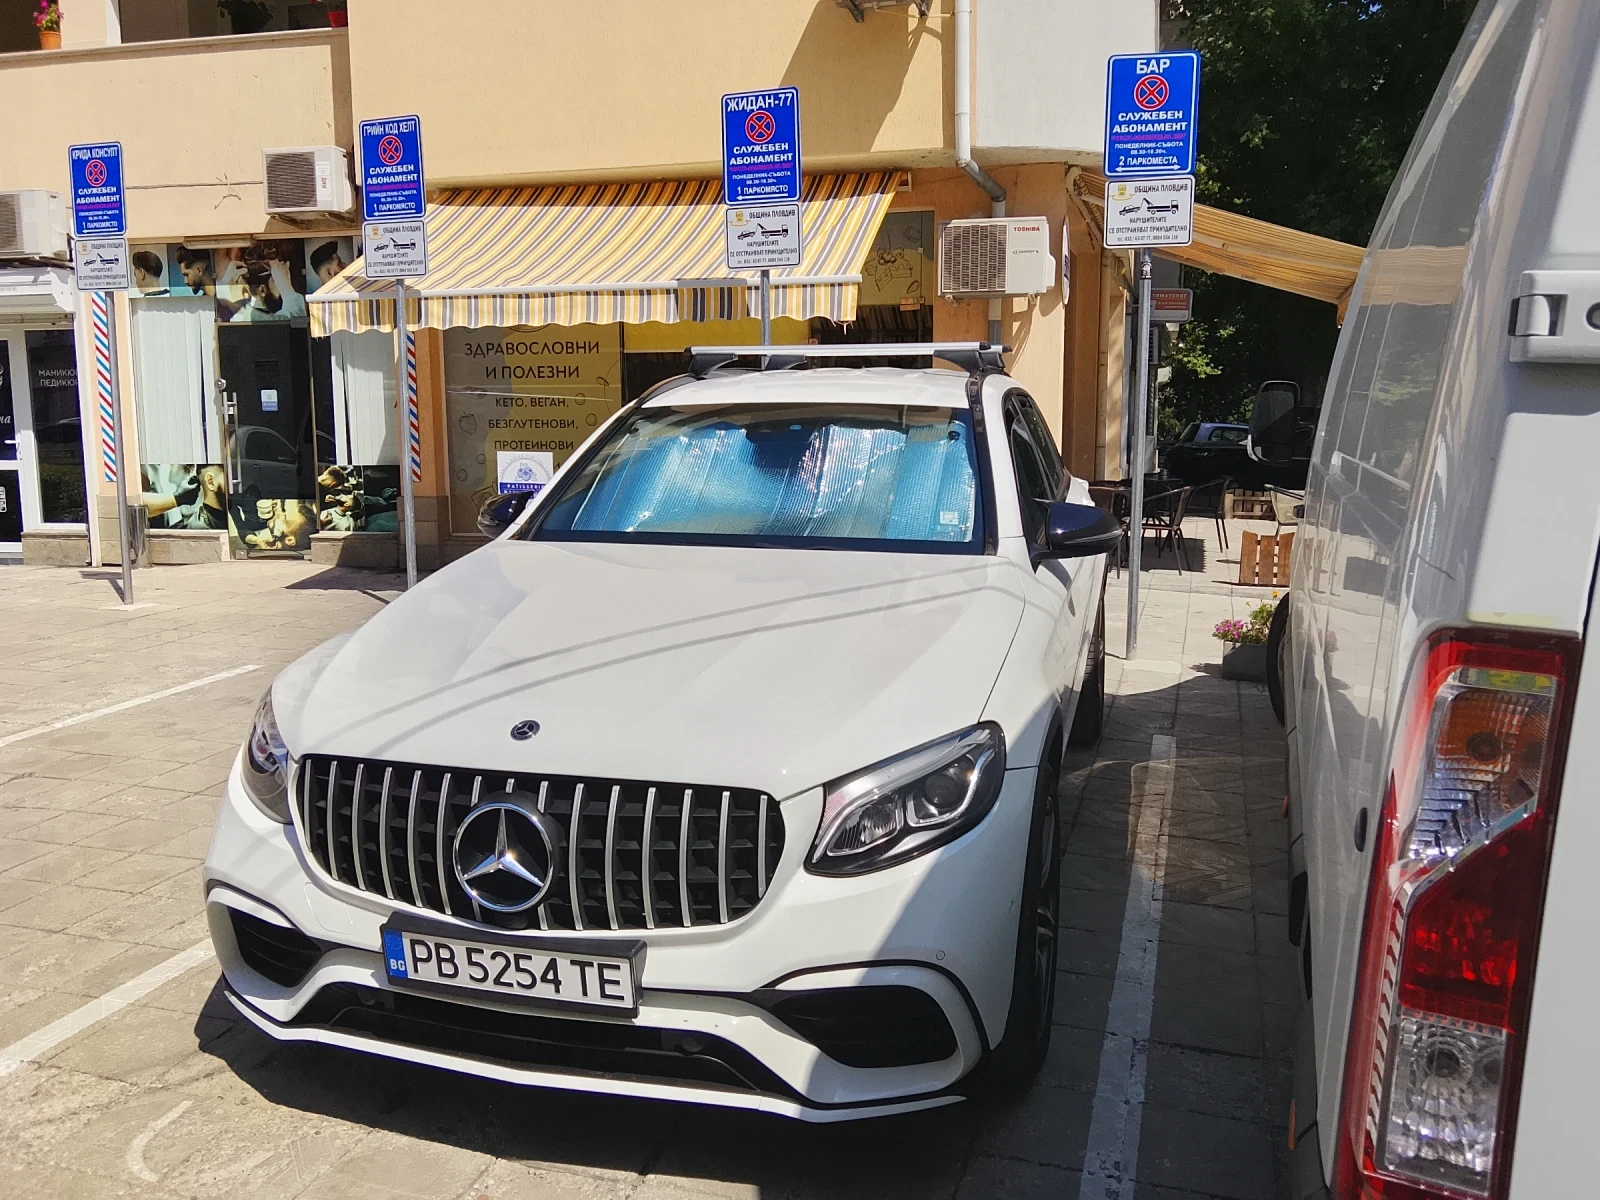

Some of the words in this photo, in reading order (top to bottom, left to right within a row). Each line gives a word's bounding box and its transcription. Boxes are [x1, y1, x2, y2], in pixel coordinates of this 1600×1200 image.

[1136, 58, 1171, 74] БАР
[727, 93, 793, 113] ЖИДАН-77
[1118, 110, 1183, 122] СЛУЖЕБЕН
[363, 123, 384, 137] ГРИЙН
[385, 122, 398, 135] КОД
[399, 120, 415, 133] ХЕЛТ
[1112, 122, 1188, 133] АБОНАМЕНТ
[733, 142, 789, 154] СЛУЖЕБЕН
[1114, 141, 1184, 149] ПОНЕДЕЛНИК-СЪБОТА
[729, 153, 793, 166] АБОНАМЕНТ
[1119, 156, 1125, 165] 2
[1127, 156, 1178, 165] ПАРКОМЕСТА
[369, 163, 414, 175] СЛУЖЕБЕН
[366, 173, 417, 185] АБОНАМЕНТ
[78, 186, 117, 195] СЛУЖЕБЕН
[737, 186, 741, 195] 1
[743, 184, 789, 195] ПАРКОМЯСТО
[1134, 185, 1160, 194] ОБЩИНА
[1160, 183, 1188, 193] ПЛОВДИВ
[76, 195, 120, 204] АБОНАМЕНТ
[373, 203, 377, 211] 1
[749, 211, 771, 219] ОБЩИНА
[771, 209, 796, 218] ПЛОВДИВ
[1129, 216, 1167, 224] НАРУШИТЕЛИТЕ
[82, 221, 86, 229] 1
[1115, 226, 1149, 234] ОТСТРАНЯВАТ
[1149, 225, 1188, 233] ПРИНУДИТЕЛНО
[464, 341, 600, 358] ЗДРАВОСЛОВНИ
[486, 366, 497, 379] И
[501, 365, 580, 379] ПОЛЕЗНИ
[495, 397, 528, 409] КЕТО,
[530, 397, 570, 409] ВЕГАН,
[488, 418, 579, 430] БЕЗГЛУТЕНОВИ,
[494, 440, 574, 450] ПРОТЕИНОВИ
[390, 958, 406, 971] BG
[409, 938, 460, 979] PB
[465, 947, 562, 994] 5254
[569, 960, 625, 1001] TE
